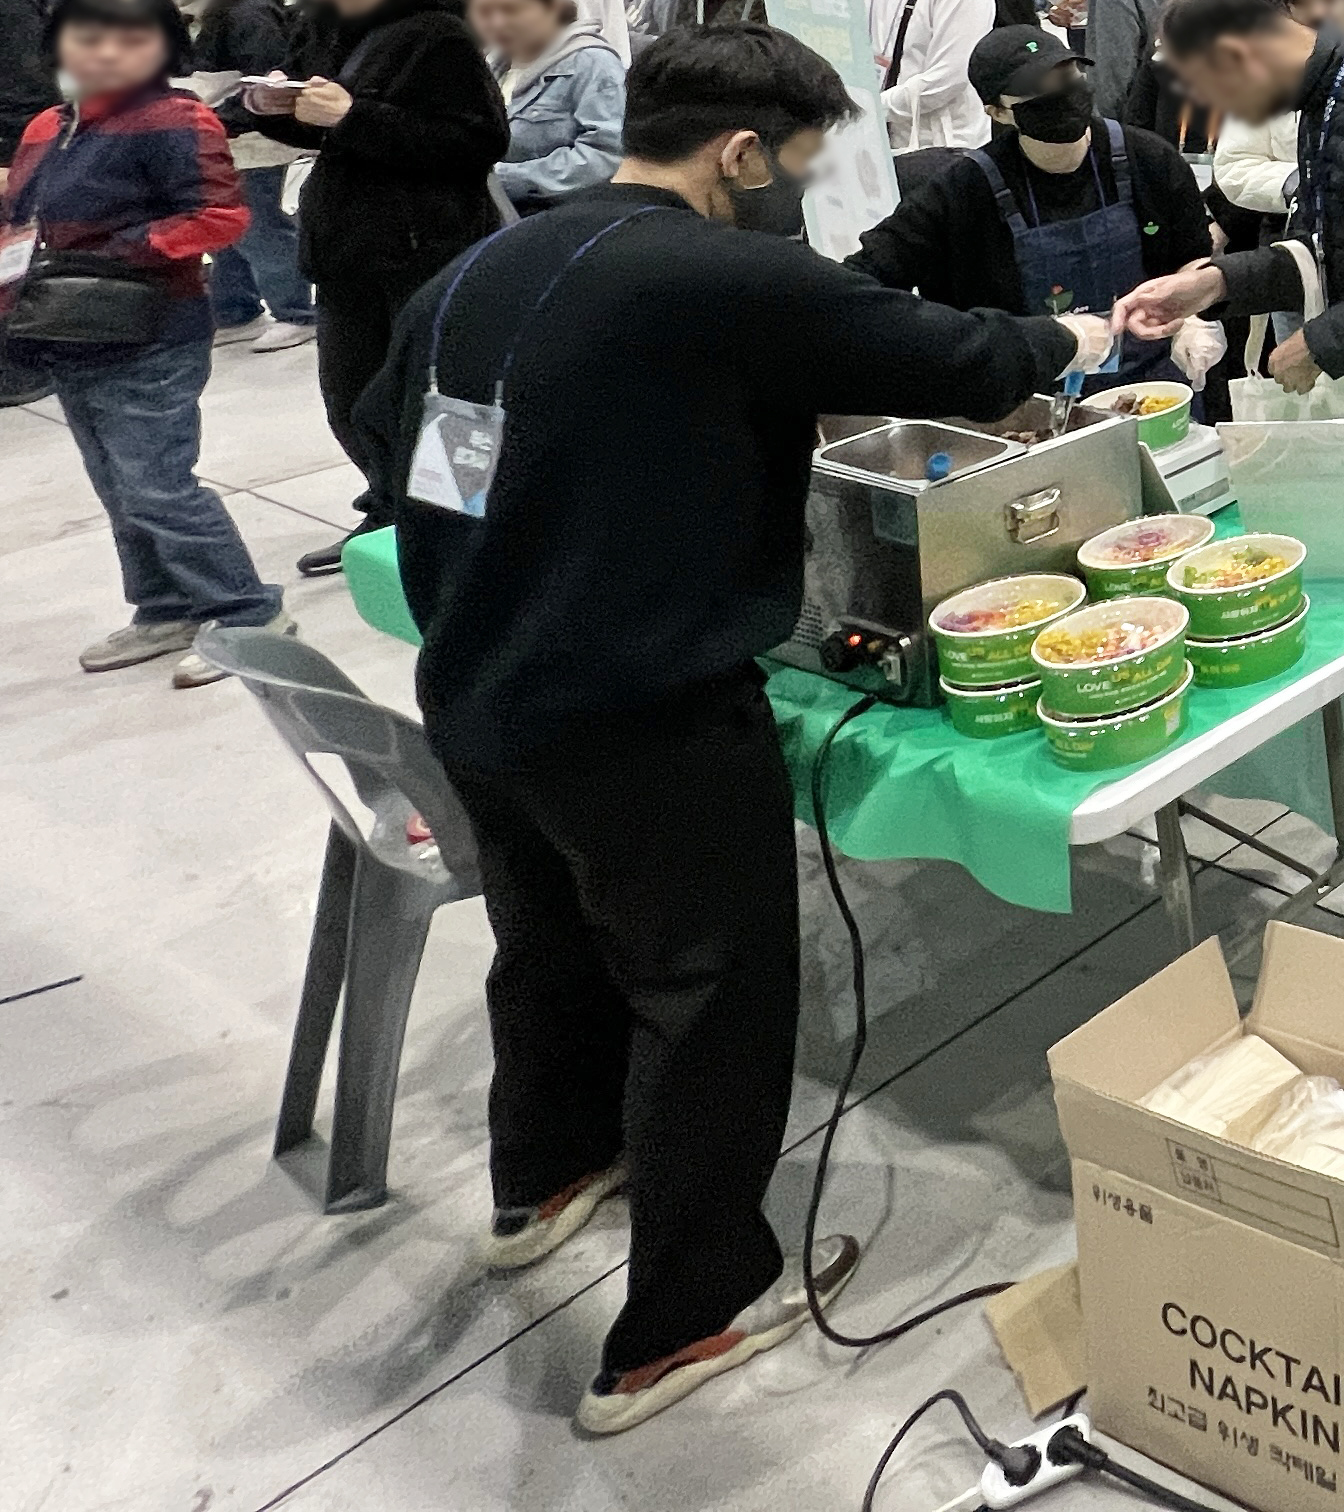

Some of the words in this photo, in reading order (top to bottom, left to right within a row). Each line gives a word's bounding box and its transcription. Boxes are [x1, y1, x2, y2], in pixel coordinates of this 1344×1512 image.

[1076, 680, 1112, 694] LOVE
[1148, 1385, 1208, 1433] 최고급
[1218, 1419, 1260, 1457] 위생
[1189, 1358, 1341, 1454] NAPKIN
